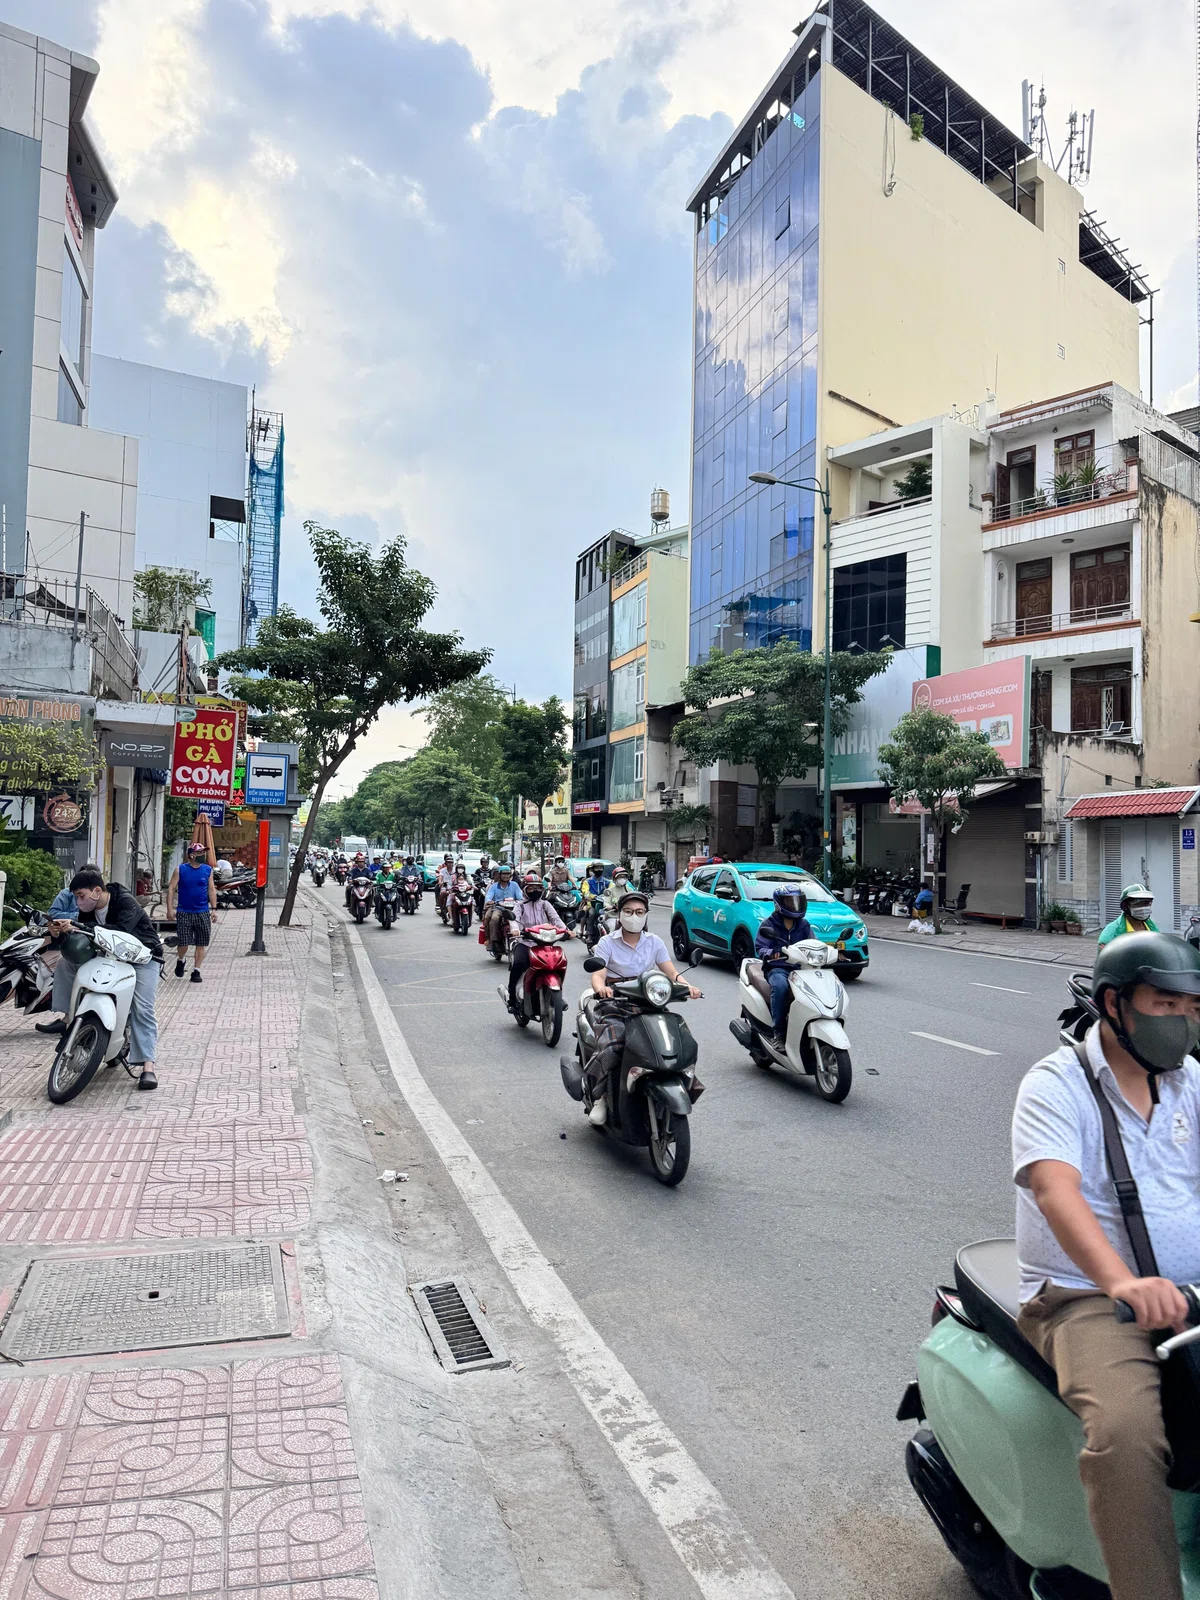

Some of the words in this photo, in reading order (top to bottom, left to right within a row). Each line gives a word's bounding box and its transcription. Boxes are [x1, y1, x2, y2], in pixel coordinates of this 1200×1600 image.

[179, 718, 234, 741] PHỞ
[110, 742, 166, 752] NO.27
[186, 742, 222, 763] GÀ
[175, 765, 230, 786] CƠM
[176, 785, 195, 794] VĂN
[197, 786, 227, 796] PHÒNG
